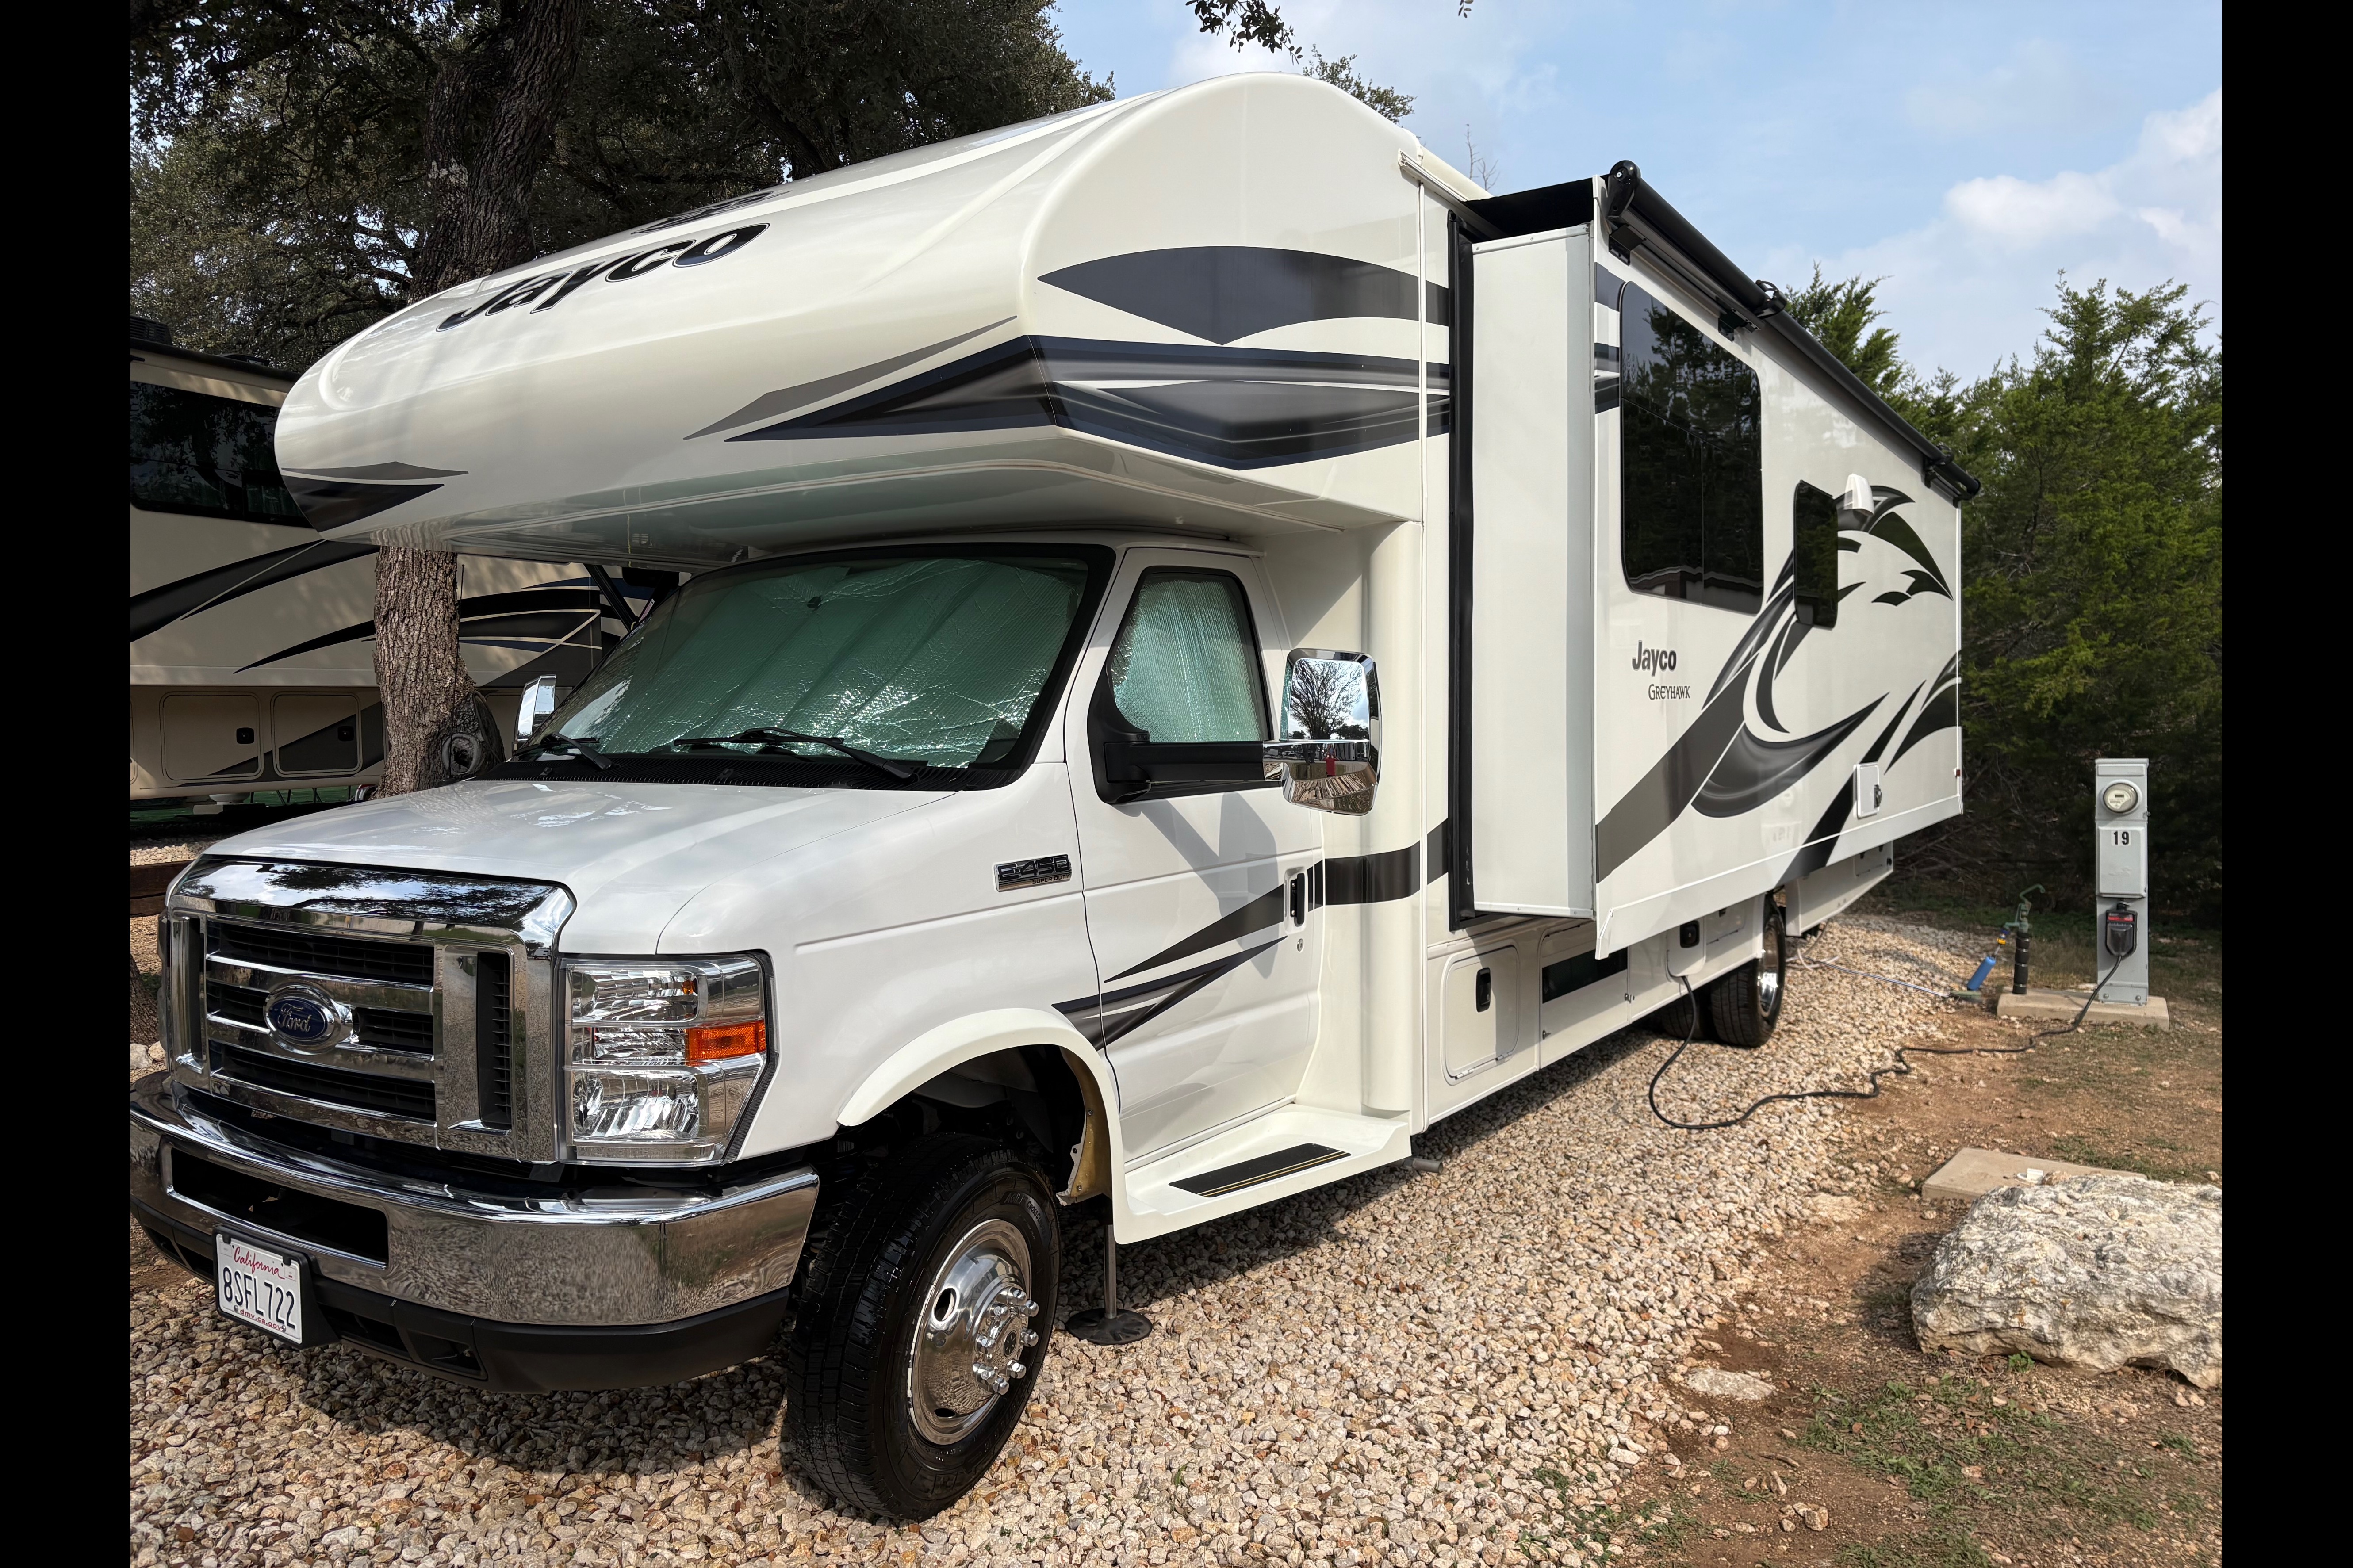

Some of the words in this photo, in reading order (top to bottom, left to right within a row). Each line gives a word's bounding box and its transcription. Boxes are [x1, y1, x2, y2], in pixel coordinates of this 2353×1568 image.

[436, 222, 770, 332] Jayco
[1632, 640, 1677, 677] Jayco
[1648, 684, 1690, 700] GREYHAWK
[2113, 830, 2130, 845] 19
[278, 1003, 312, 1033] Ford
[234, 1246, 285, 1280] California
[223, 1266, 295, 1329] 8SFL722
[240, 1309, 282, 1330] dmv.ca.gov
